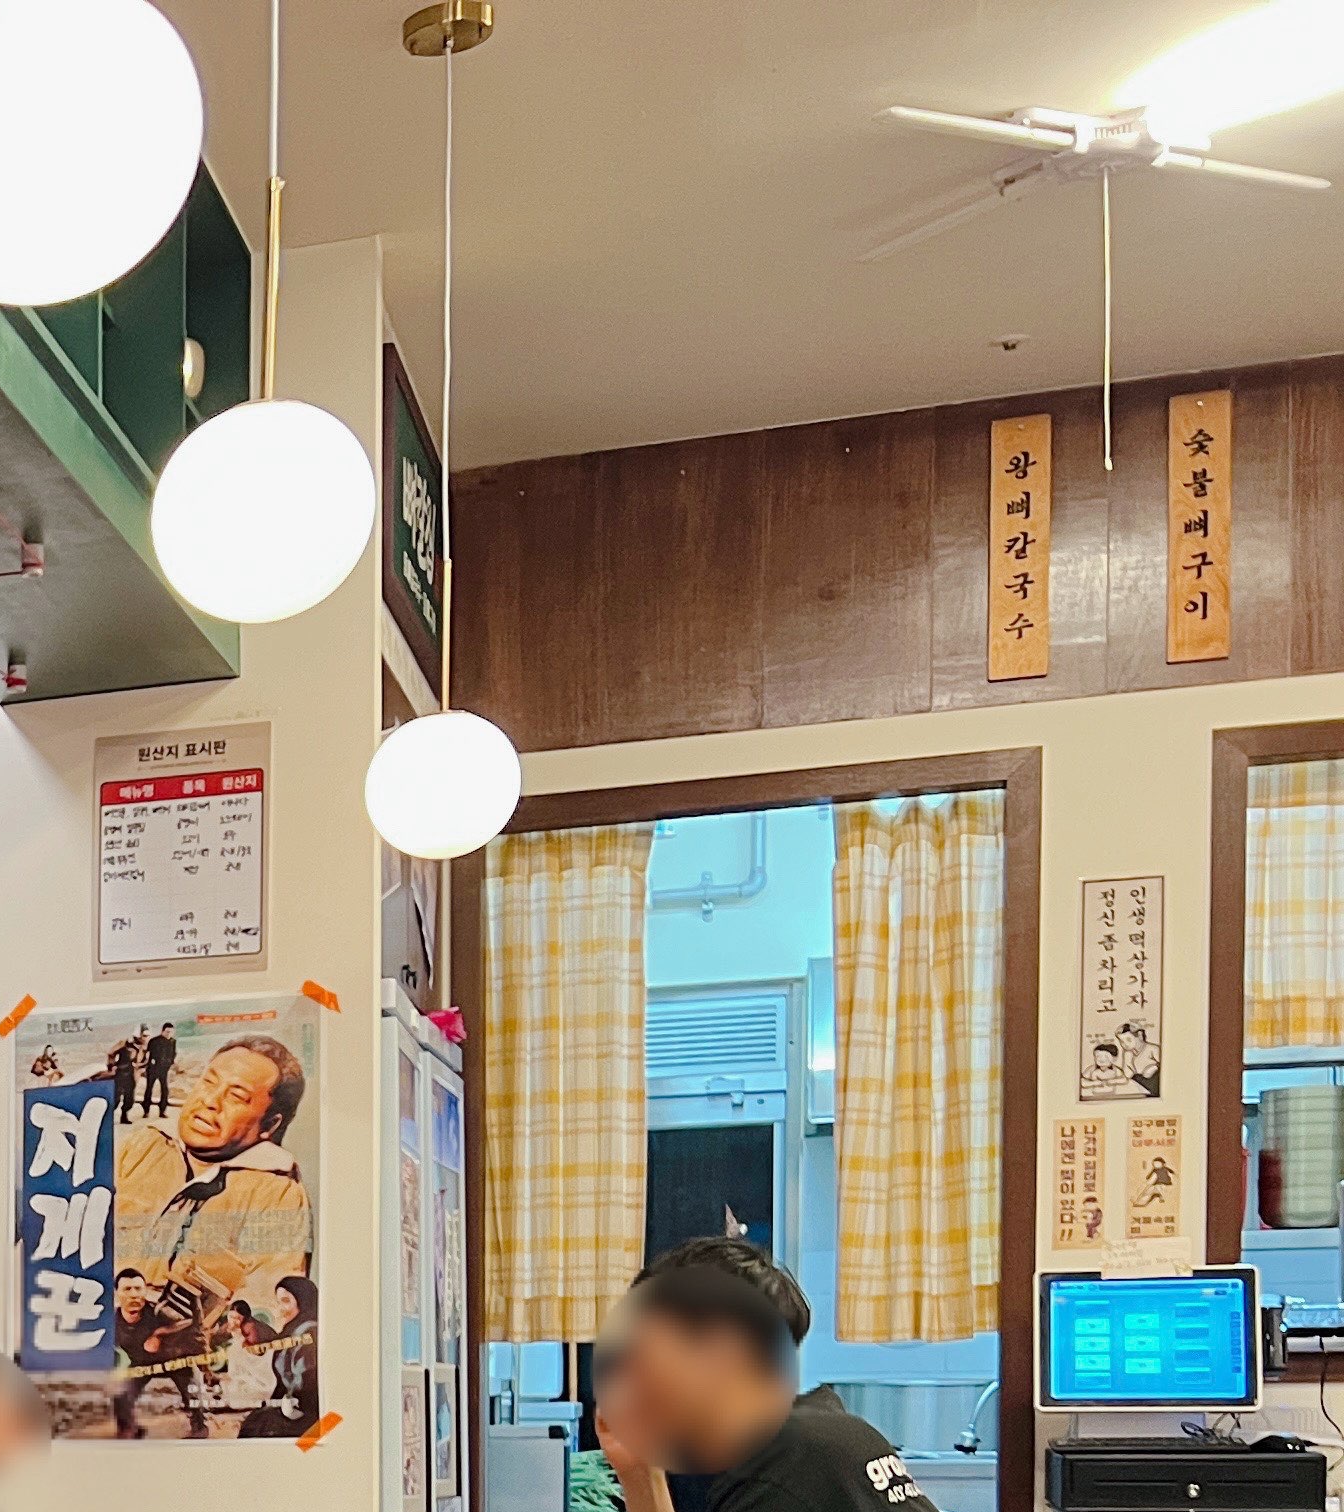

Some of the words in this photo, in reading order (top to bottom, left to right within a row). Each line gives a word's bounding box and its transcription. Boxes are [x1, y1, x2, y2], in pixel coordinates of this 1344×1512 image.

[1004, 451, 1037, 640] 왕뼈칼국수
[1181, 428, 1214, 620] 숯불뼈구이
[138, 743, 179, 763] 원산지
[184, 739, 227, 757] 표시판
[221, 774, 257, 792] 원산지
[1127, 885, 1146, 925] 인생
[28, 1096, 112, 1351] 지게꾼
